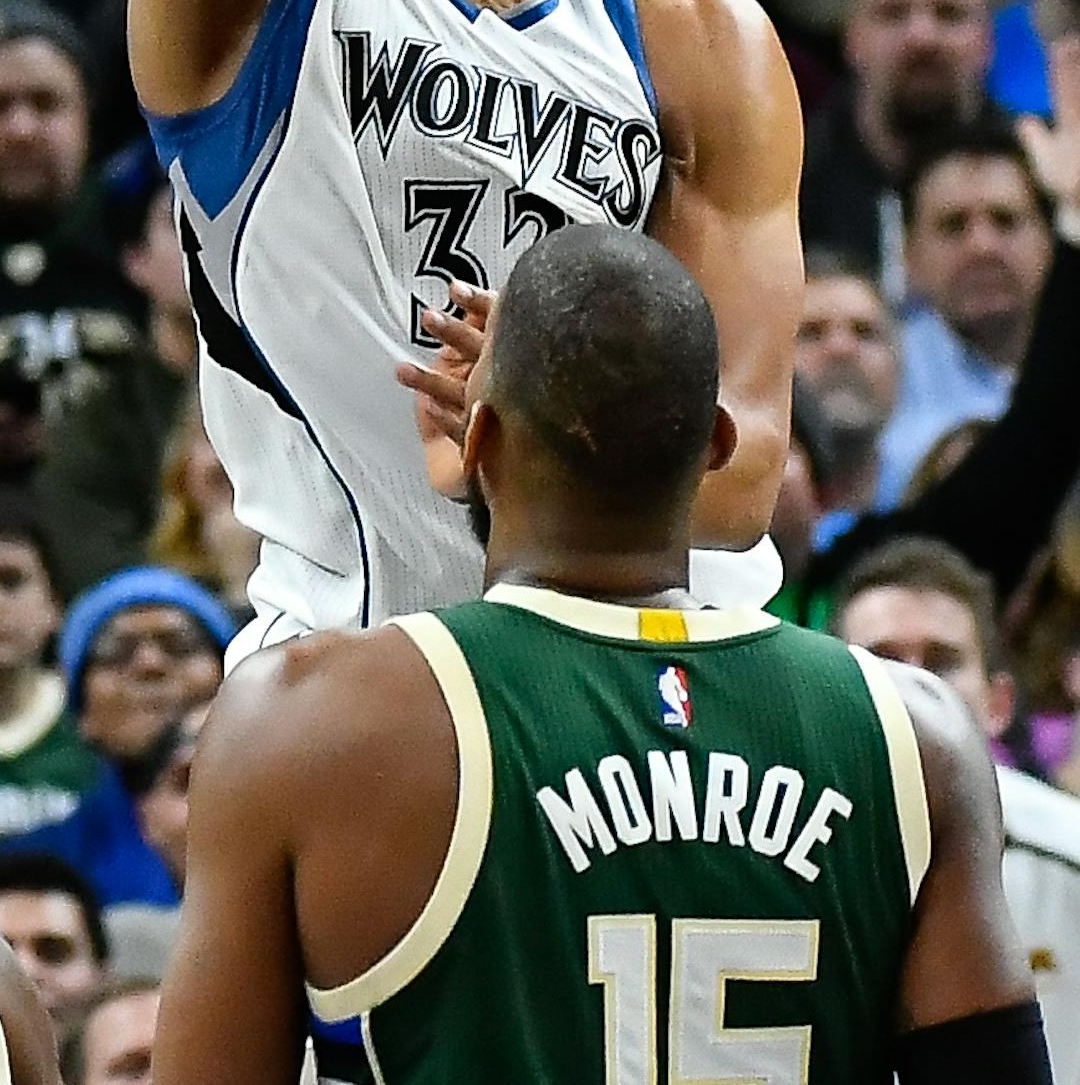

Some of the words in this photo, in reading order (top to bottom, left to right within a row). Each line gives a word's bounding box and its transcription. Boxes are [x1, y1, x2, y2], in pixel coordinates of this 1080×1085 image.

[333, 30, 663, 232] WOLVES
[536, 750, 854, 883] MONROE
[587, 913, 820, 1085] 15
